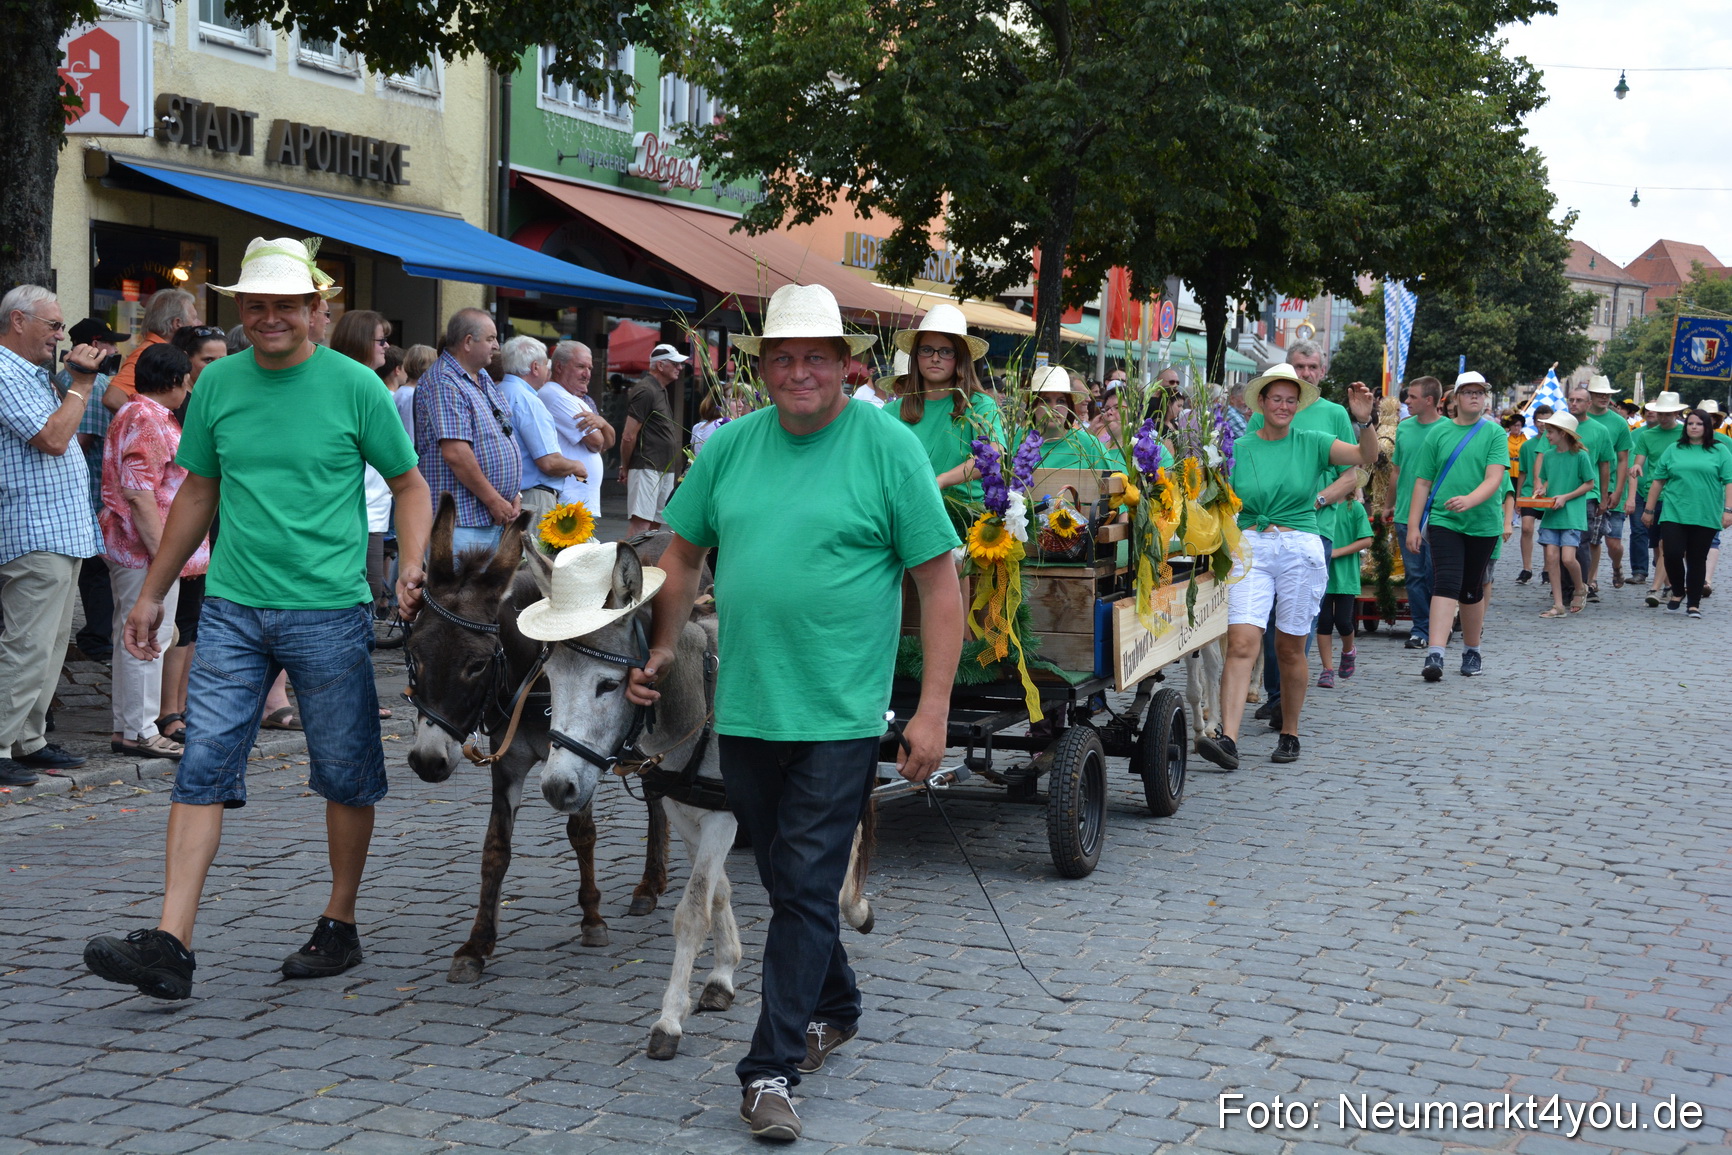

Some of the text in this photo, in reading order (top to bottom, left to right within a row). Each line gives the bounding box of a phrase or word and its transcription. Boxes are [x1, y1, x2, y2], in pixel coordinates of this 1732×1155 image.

[160, 93, 411, 186] STADT APOTHEKE
[577, 147, 627, 174] METZGEREI
[635, 132, 703, 191] Bögerl
[1279, 297, 1305, 312] H&M
[1681, 356, 1725, 372] Beratzhausen
[1178, 624, 1193, 651] des
